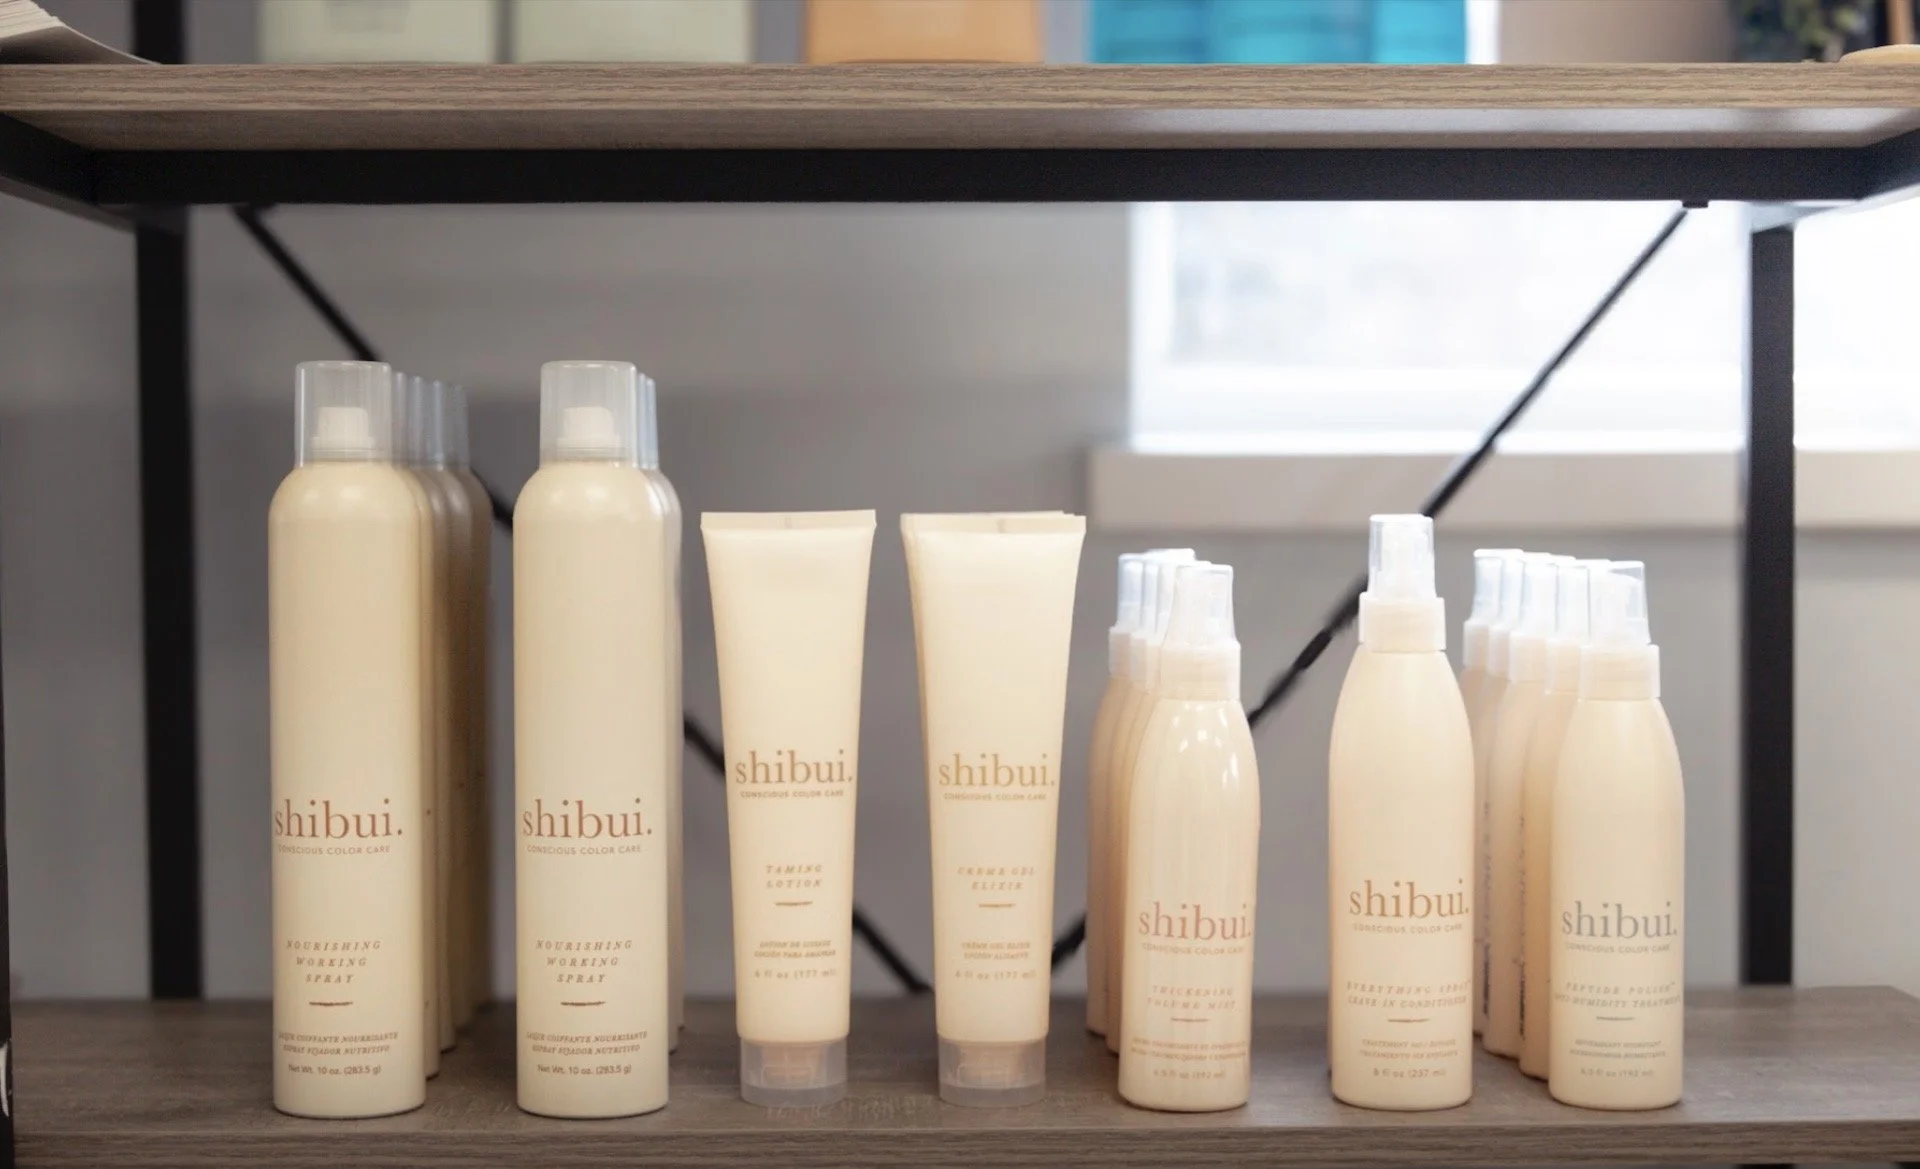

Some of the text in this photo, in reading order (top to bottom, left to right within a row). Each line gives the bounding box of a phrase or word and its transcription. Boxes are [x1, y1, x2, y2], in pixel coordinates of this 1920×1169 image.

[735, 749, 853, 784] shibui.
[939, 752, 1055, 786] shibui.
[274, 798, 403, 839] shibui.
[522, 797, 653, 838] shibui.
[327, 846, 362, 855] COLOR
[366, 845, 390, 854] CARE
[527, 844, 642, 855] CONSCIOUS COLOR CARE
[766, 864, 823, 874] TAMING
[766, 879, 823, 888] LOTION
[1349, 879, 1469, 918] shibui.
[1139, 901, 1251, 940] shibui.
[1561, 900, 1677, 938] shibui.
[286, 940, 381, 951] NOURISHING
[535, 940, 633, 951] NOURISHING
[296, 957, 367, 968] WORKING
[547, 957, 619, 967] WORKING
[305, 974, 354, 983] SPRAY
[557, 974, 606, 983] SPRAY
[288, 1064, 300, 1073] Net
[318, 1066, 328, 1074] 10
[344, 1066, 370, 1075] (283.5
[537, 1064, 550, 1073] Net
[569, 1066, 579, 1075] 10
[596, 1066, 622, 1075] (283.5
